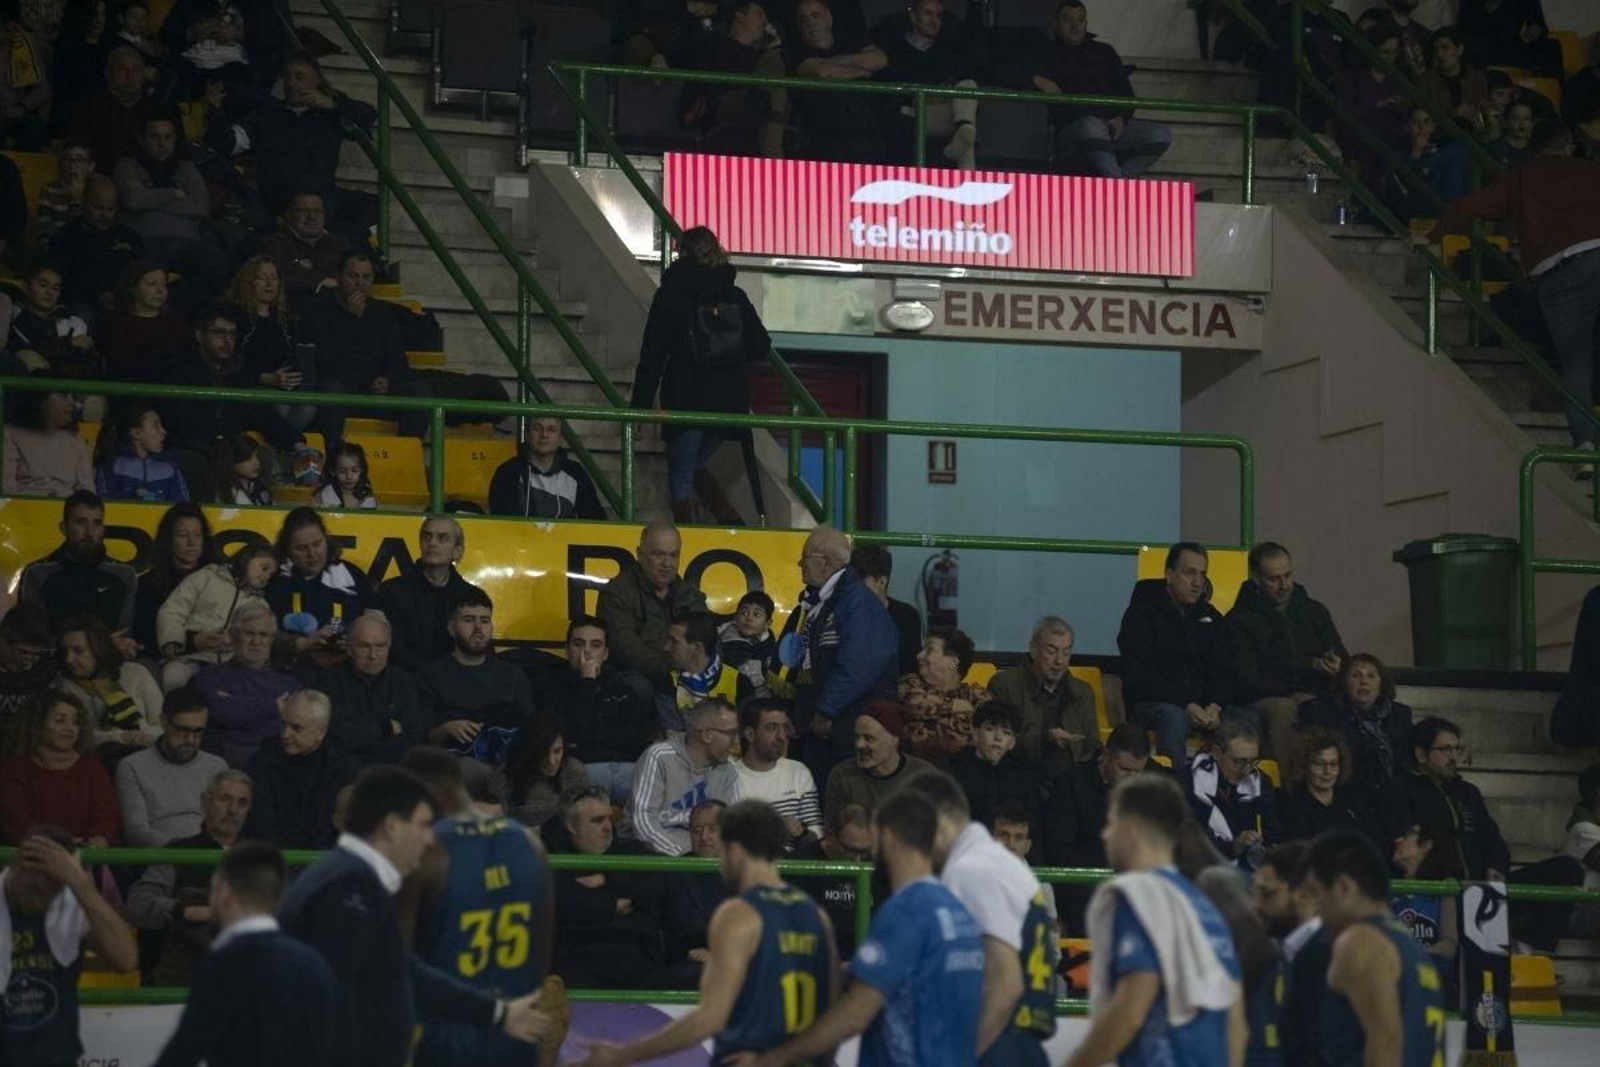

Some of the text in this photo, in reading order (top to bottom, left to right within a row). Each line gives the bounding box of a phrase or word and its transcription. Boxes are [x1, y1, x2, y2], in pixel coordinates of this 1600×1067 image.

[850, 216, 1013, 256] telemiño
[944, 290, 1236, 338] EMERXENCIA
[458, 902, 531, 978] 35
